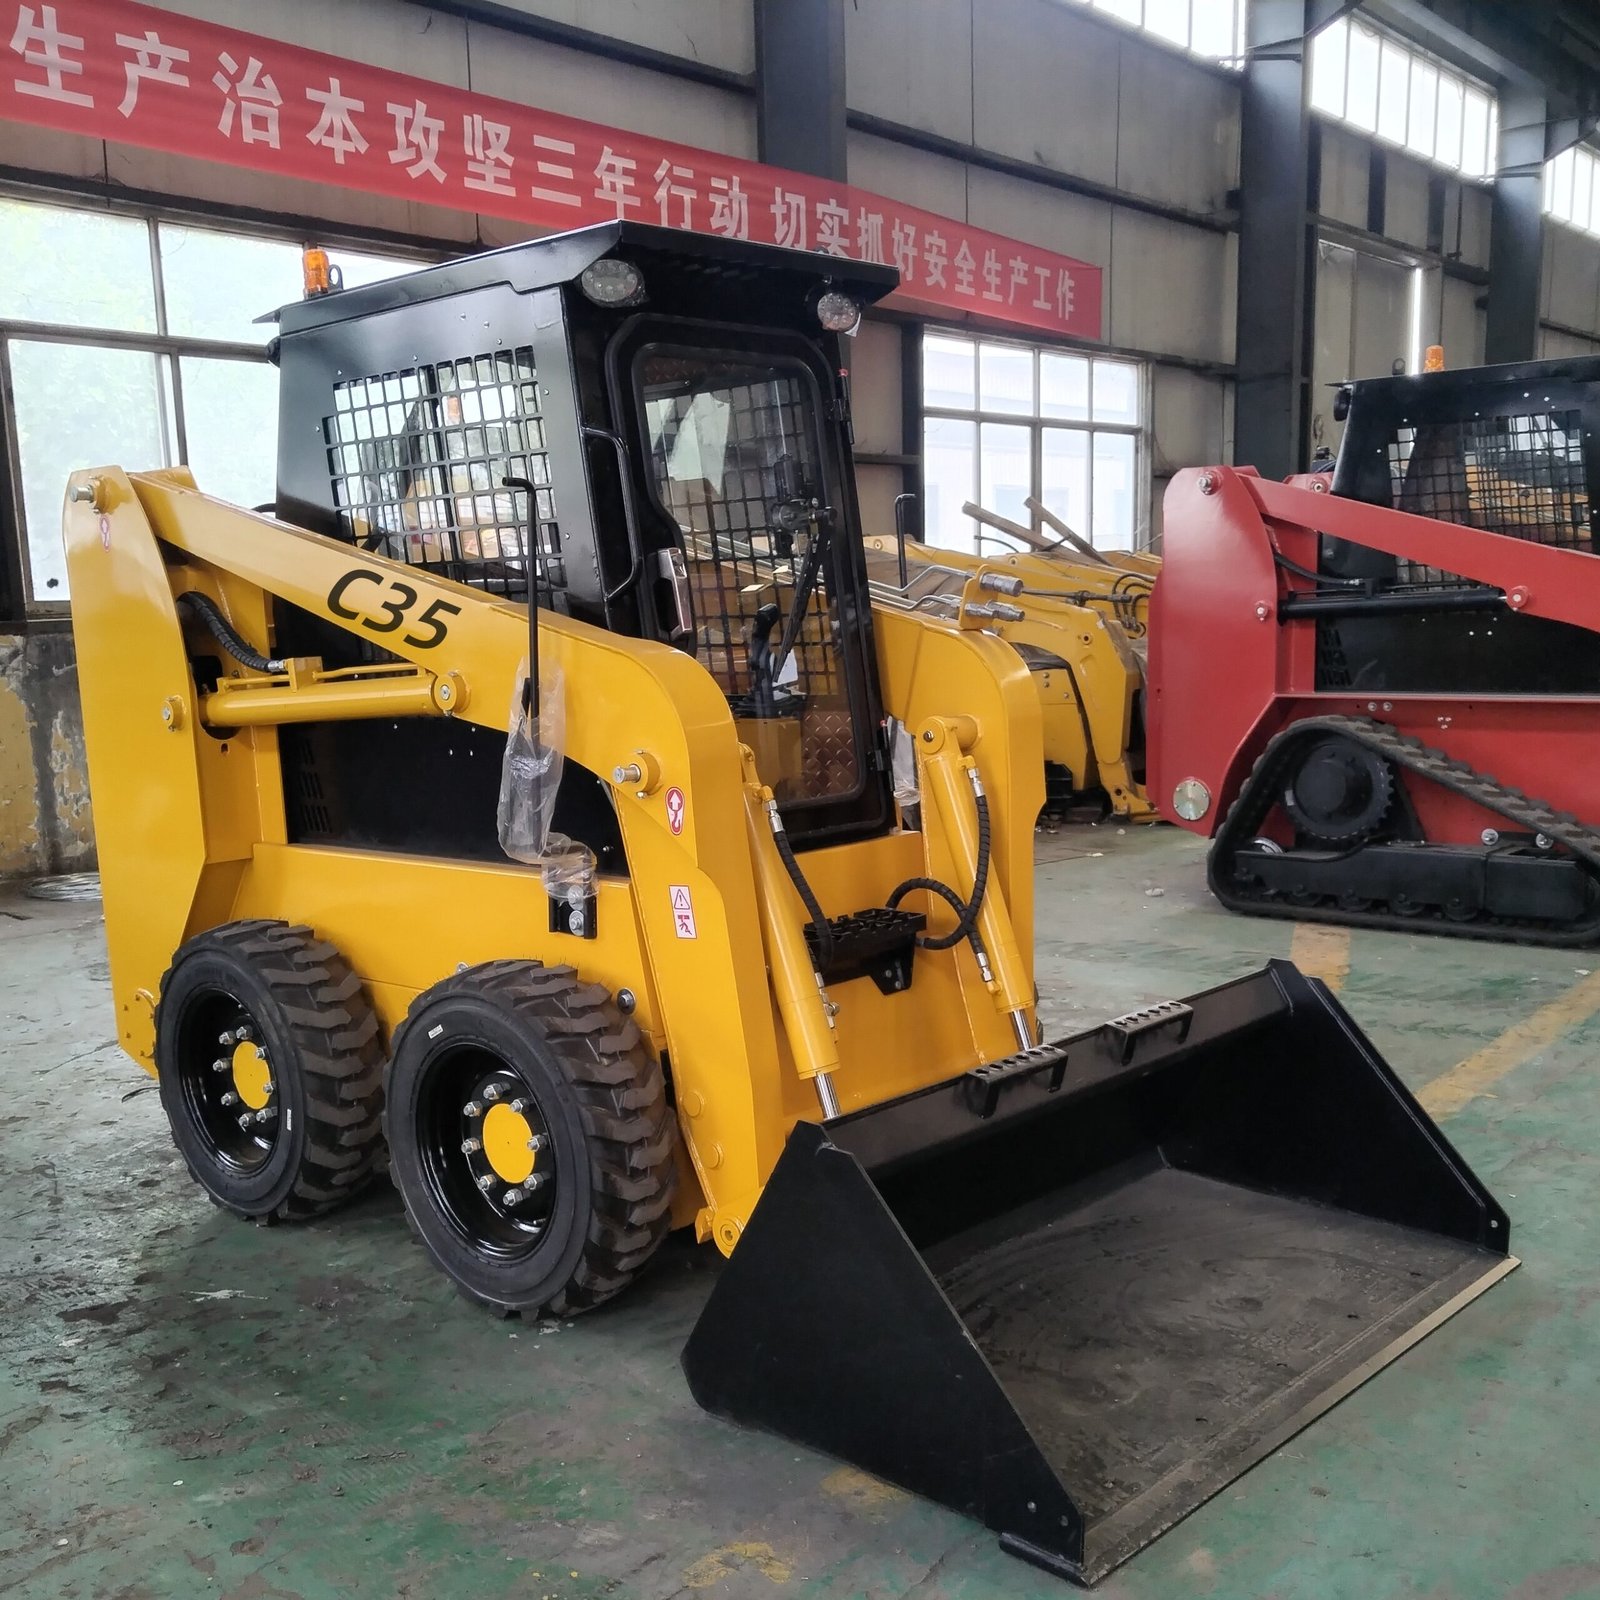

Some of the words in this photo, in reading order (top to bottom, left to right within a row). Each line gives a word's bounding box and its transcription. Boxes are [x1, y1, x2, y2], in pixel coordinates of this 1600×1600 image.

[9, 4, 749, 241] 生产治本攻坚三年行动
[769, 186, 1076, 320] 切实抓好安全生产工作
[327, 569, 462, 649] C35
